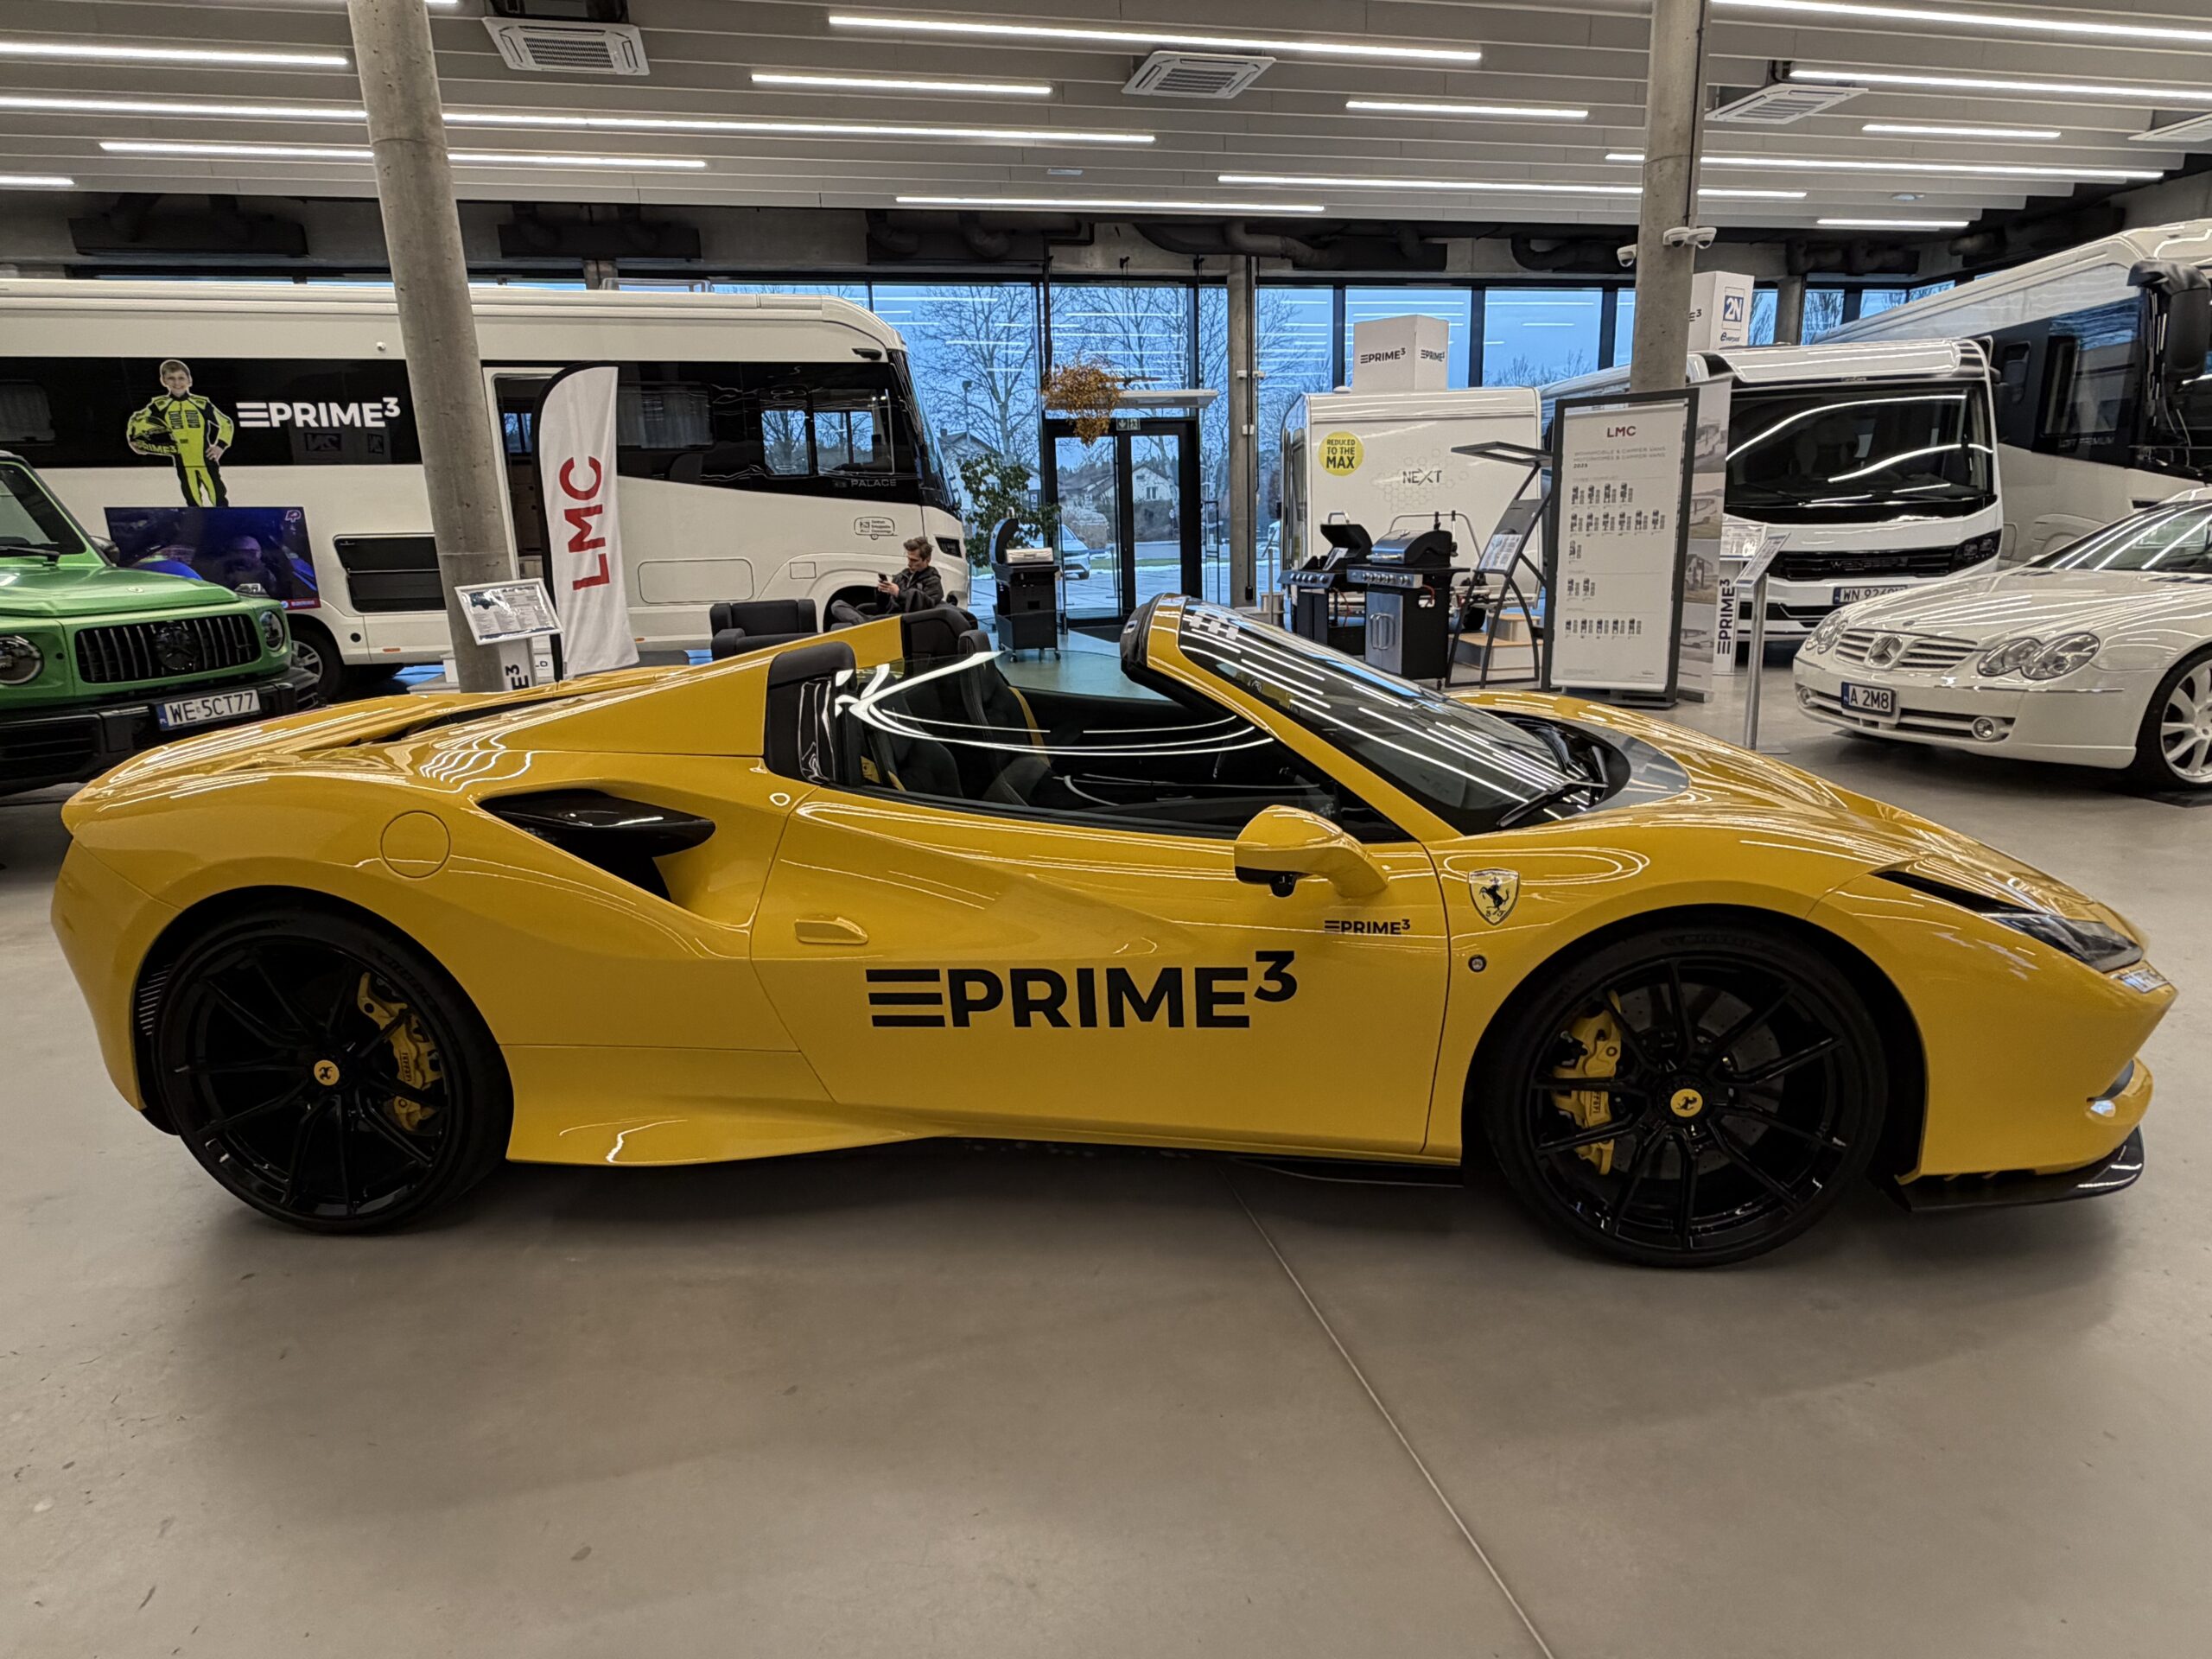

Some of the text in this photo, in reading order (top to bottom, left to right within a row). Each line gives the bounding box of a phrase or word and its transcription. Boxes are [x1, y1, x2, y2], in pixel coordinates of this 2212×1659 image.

[1724, 296, 1743, 321] 2N
[1606, 425, 1637, 438] LMC
[1327, 446, 1356, 455] TO THE
[1326, 455, 1355, 469] MAX
[850, 478, 897, 487] PALACE
[1402, 467, 1442, 486] NEXT
[559, 455, 611, 591] LMC
[1843, 588, 1860, 601] WN
[1850, 687, 1890, 709] A 2M8
[169, 692, 253, 723] WE 5CT77
